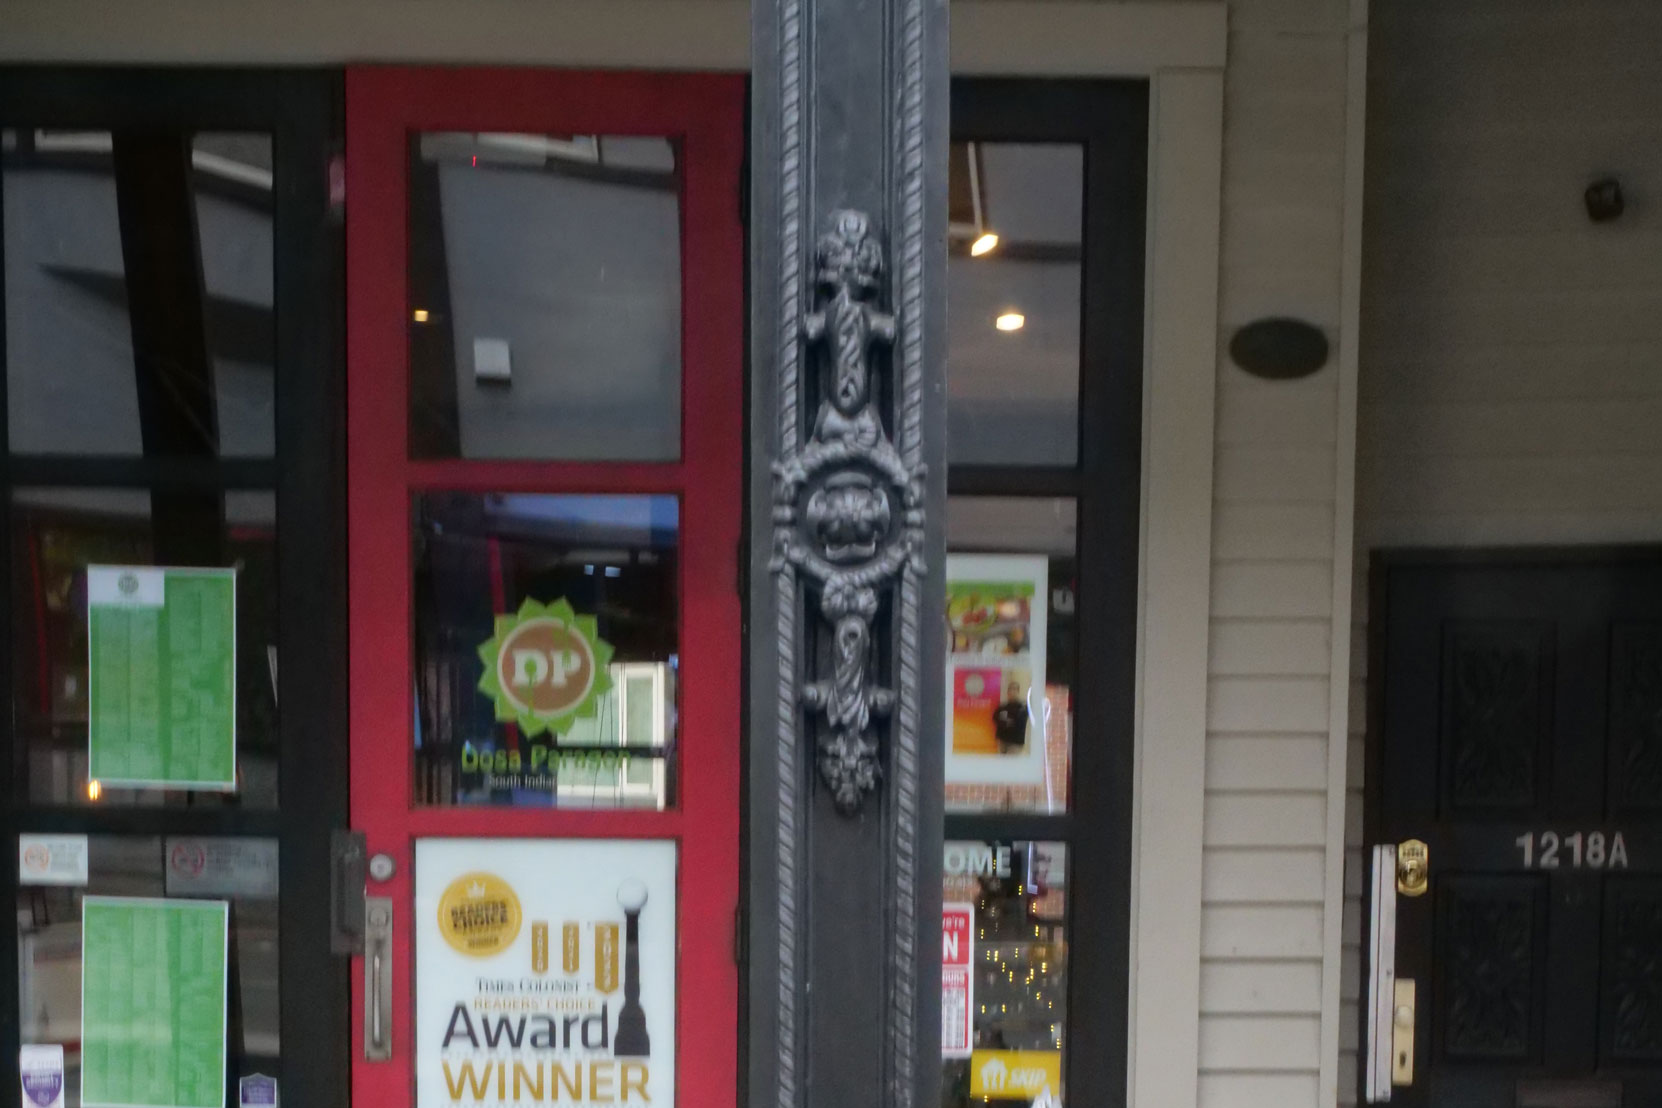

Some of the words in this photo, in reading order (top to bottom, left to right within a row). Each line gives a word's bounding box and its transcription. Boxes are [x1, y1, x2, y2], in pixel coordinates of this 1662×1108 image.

[512, 648, 582, 688] DP
[461, 743, 521, 773] Dosa
[531, 744, 632, 773] Paragon
[1515, 830, 1629, 870] 1218A
[441, 1000, 609, 1050] Award
[441, 1060, 652, 1103] WINNER
[1009, 1068, 1047, 1088] SKIP
